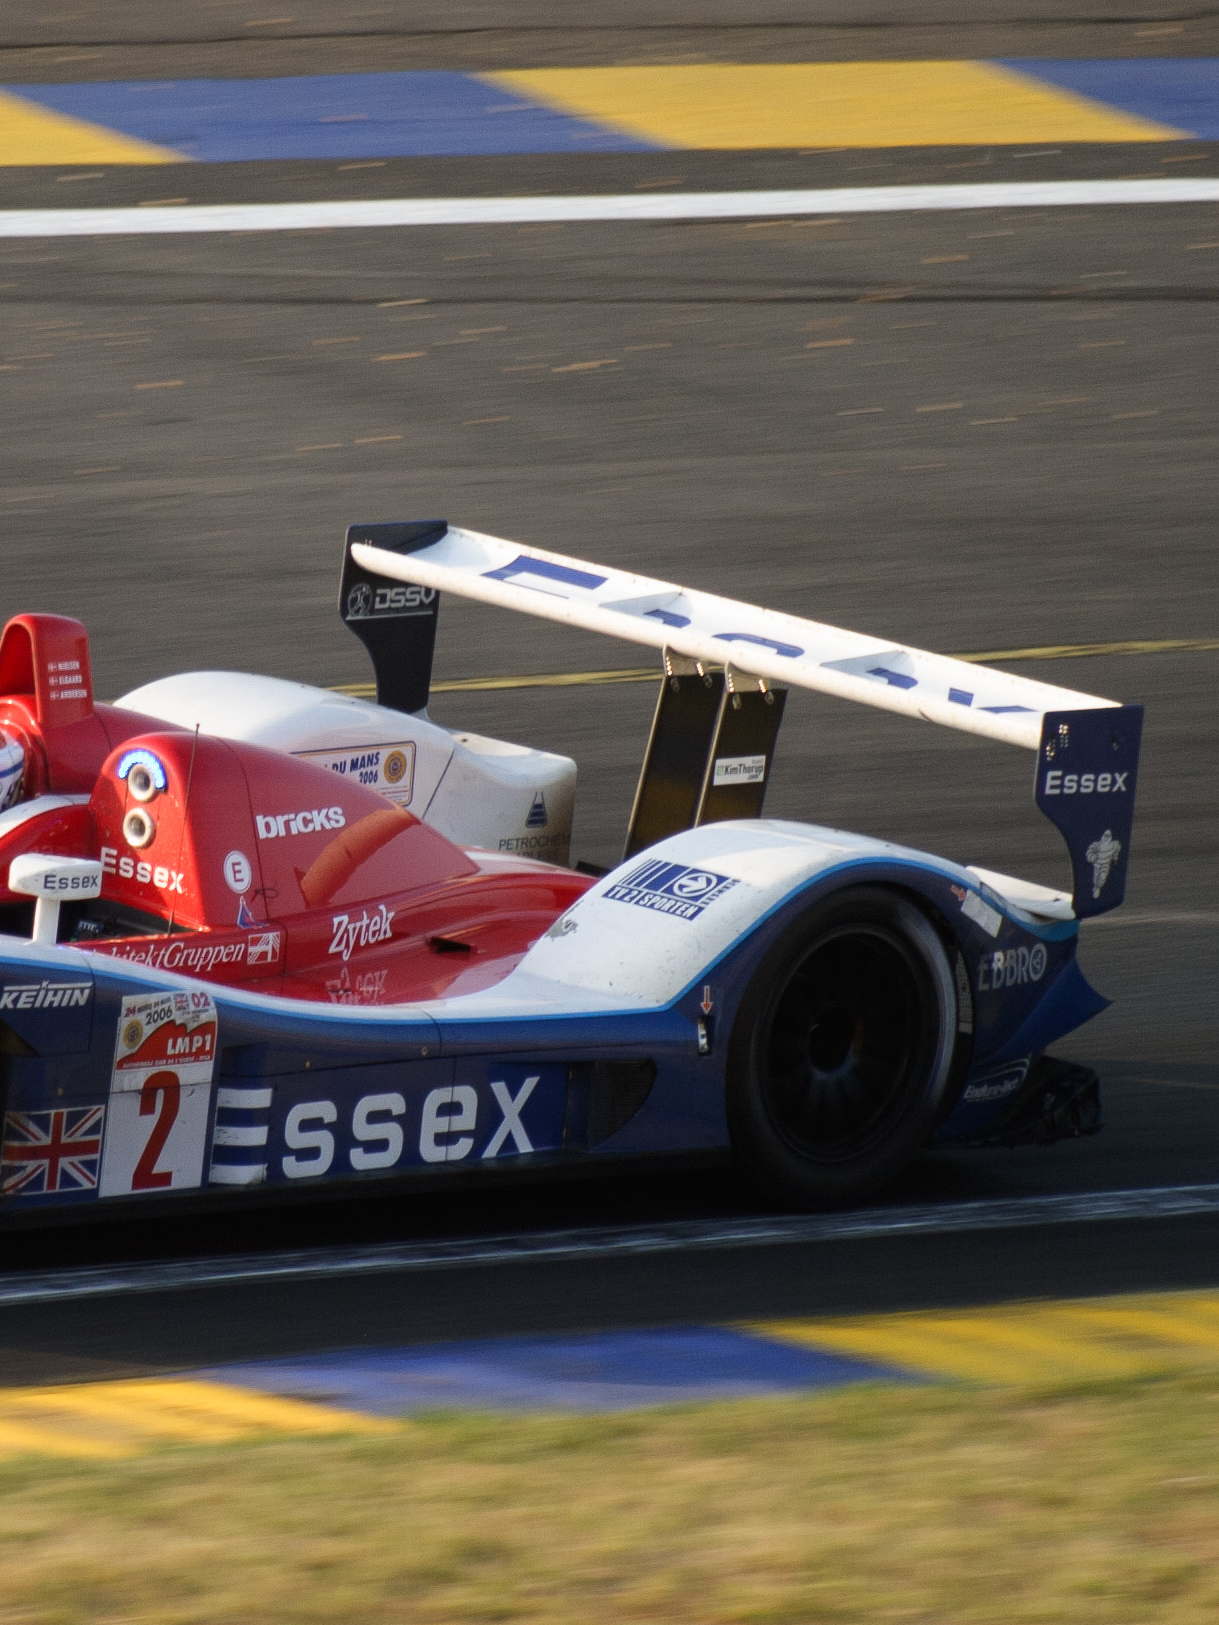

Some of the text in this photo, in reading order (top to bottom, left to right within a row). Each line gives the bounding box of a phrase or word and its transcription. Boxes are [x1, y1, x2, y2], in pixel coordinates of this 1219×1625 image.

[374, 586, 436, 610] DSSV
[349, 751, 381, 773] MANS
[1044, 770, 1129, 795] Essex
[255, 806, 346, 839] bricks
[43, 874, 99, 890] Essex
[99, 846, 185, 895] Essex
[231, 860, 245, 883] E
[607, 885, 627, 899] TV
[638, 892, 699, 919] SPORTEN
[328, 904, 395, 962] Zytek
[977, 943, 1047, 991] EBBRO
[190, 991, 211, 1009] 02
[145, 1004, 173, 1026] 2006
[131, 1069, 181, 1191] 2
[208, 1075, 541, 1186] Essex
